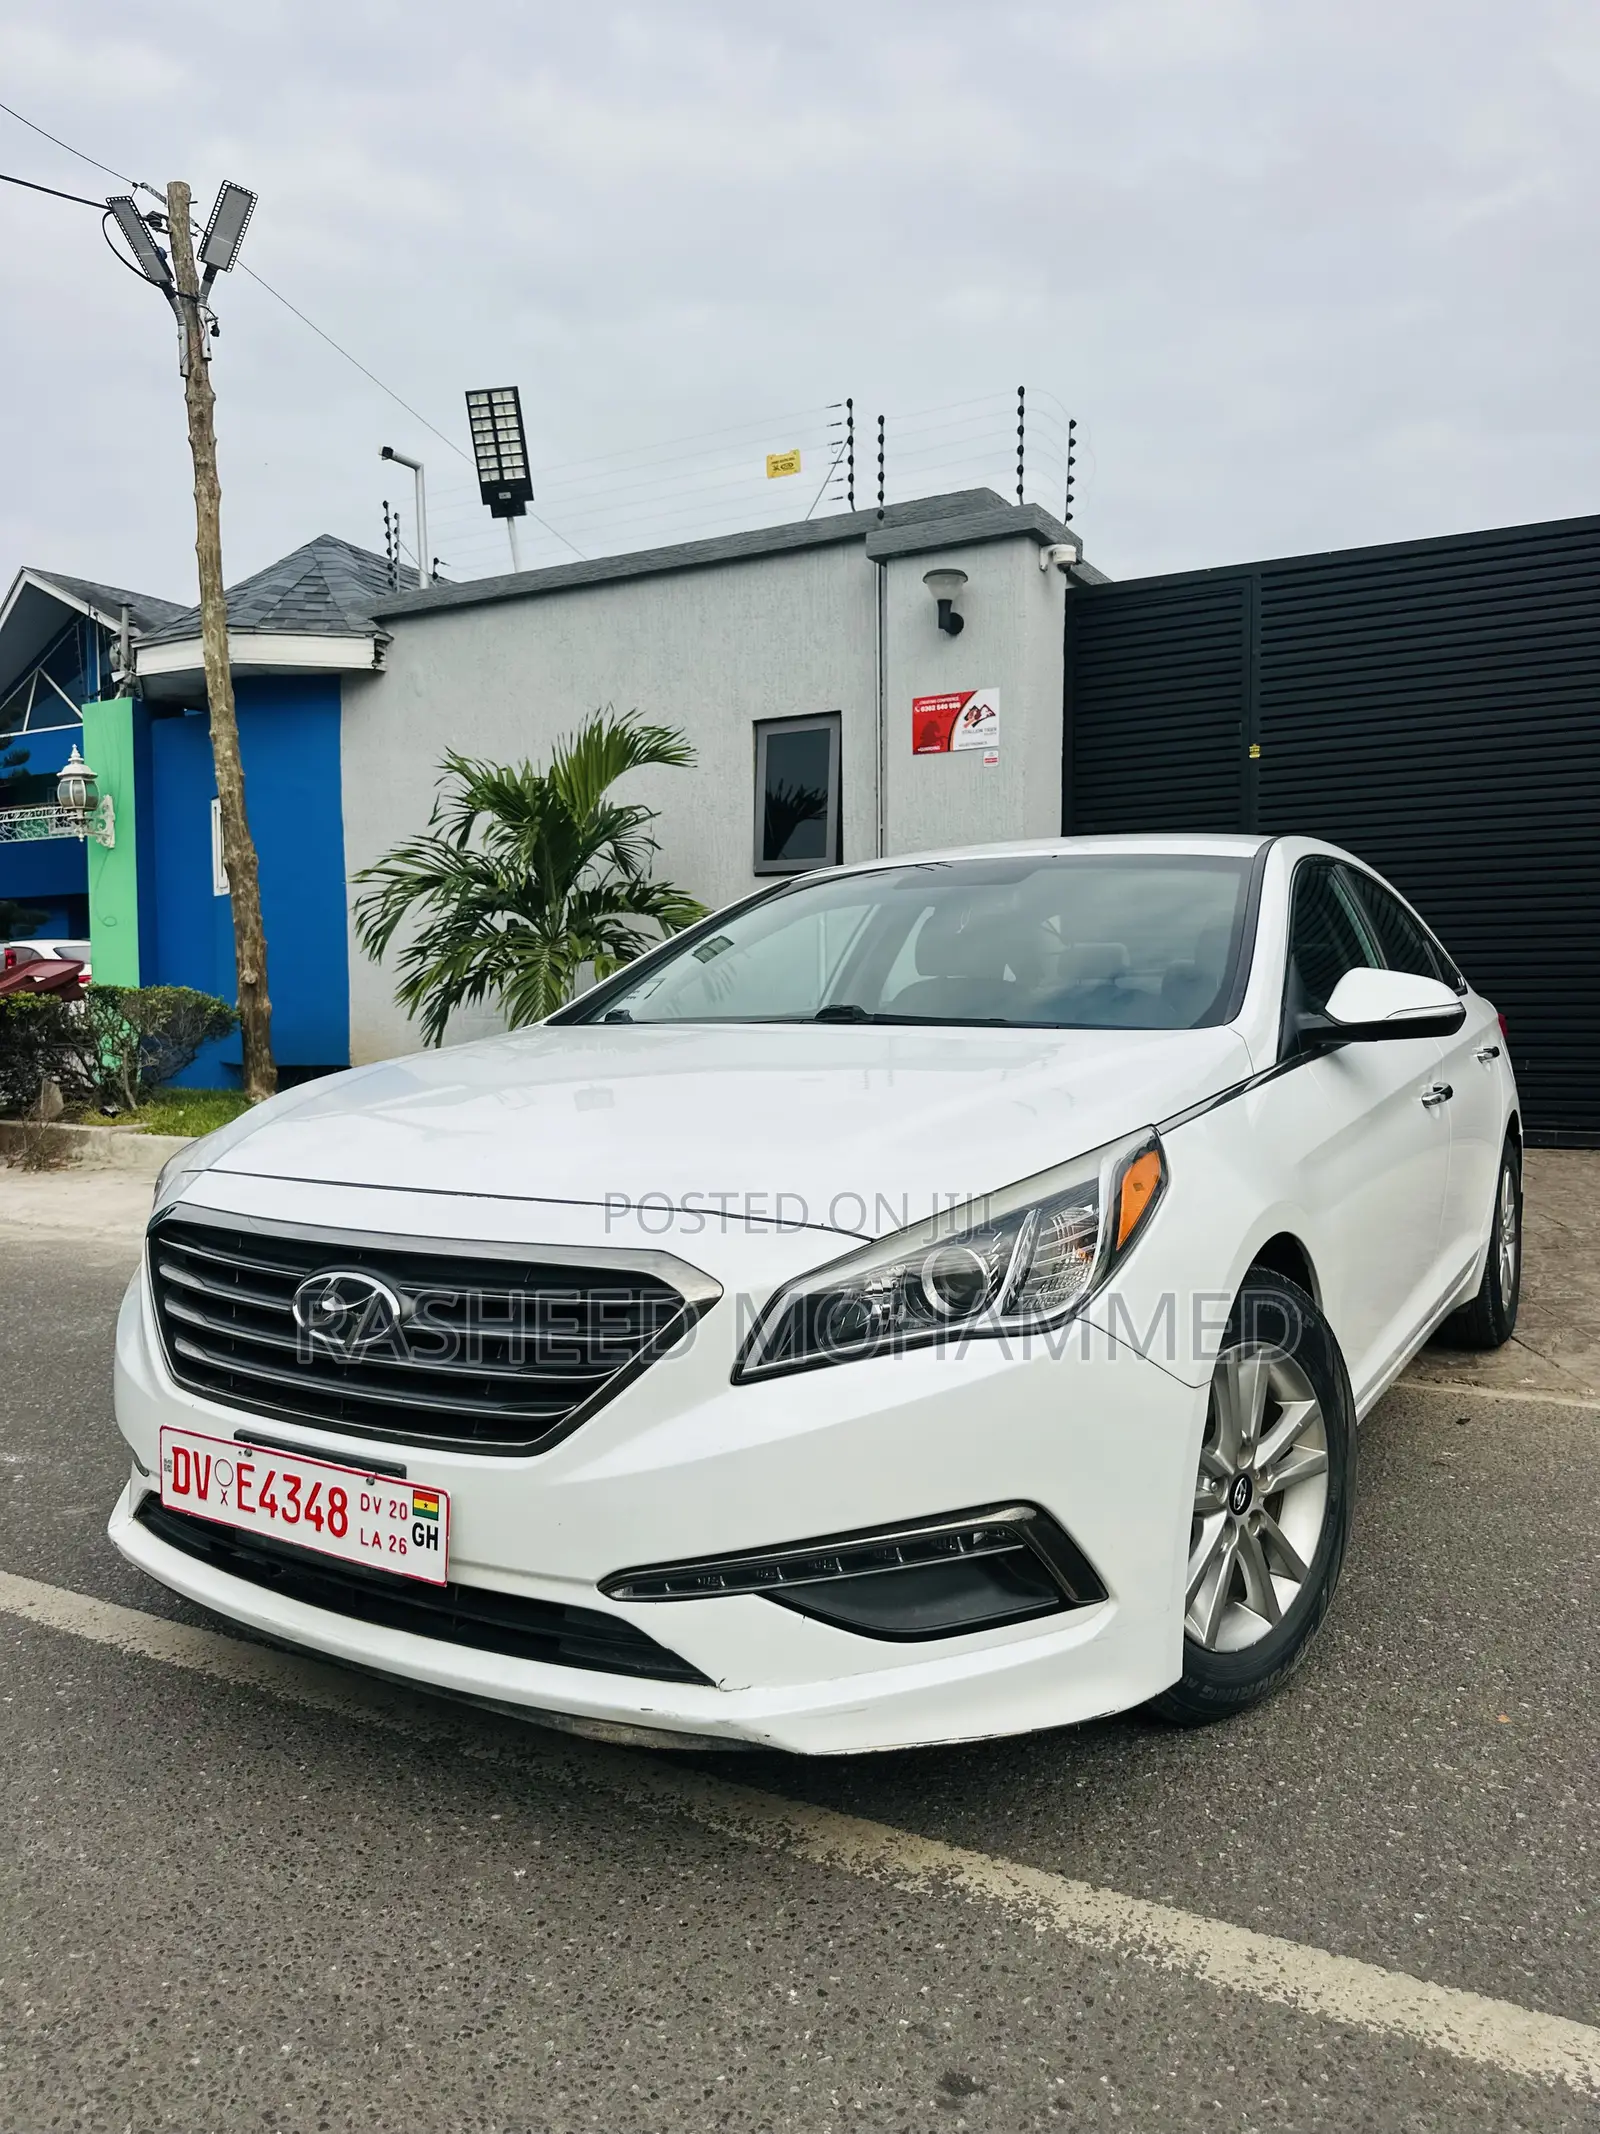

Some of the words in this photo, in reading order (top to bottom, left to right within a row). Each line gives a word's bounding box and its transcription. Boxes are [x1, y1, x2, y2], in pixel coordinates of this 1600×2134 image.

[171, 1445, 211, 1501] DV
[236, 1462, 349, 1539] E4348
[360, 1492, 383, 1515] DV
[389, 1499, 409, 1521] 20
[360, 1527, 383, 1550] LA
[388, 1533, 408, 1556] 26
[411, 1521, 440, 1551] GH
